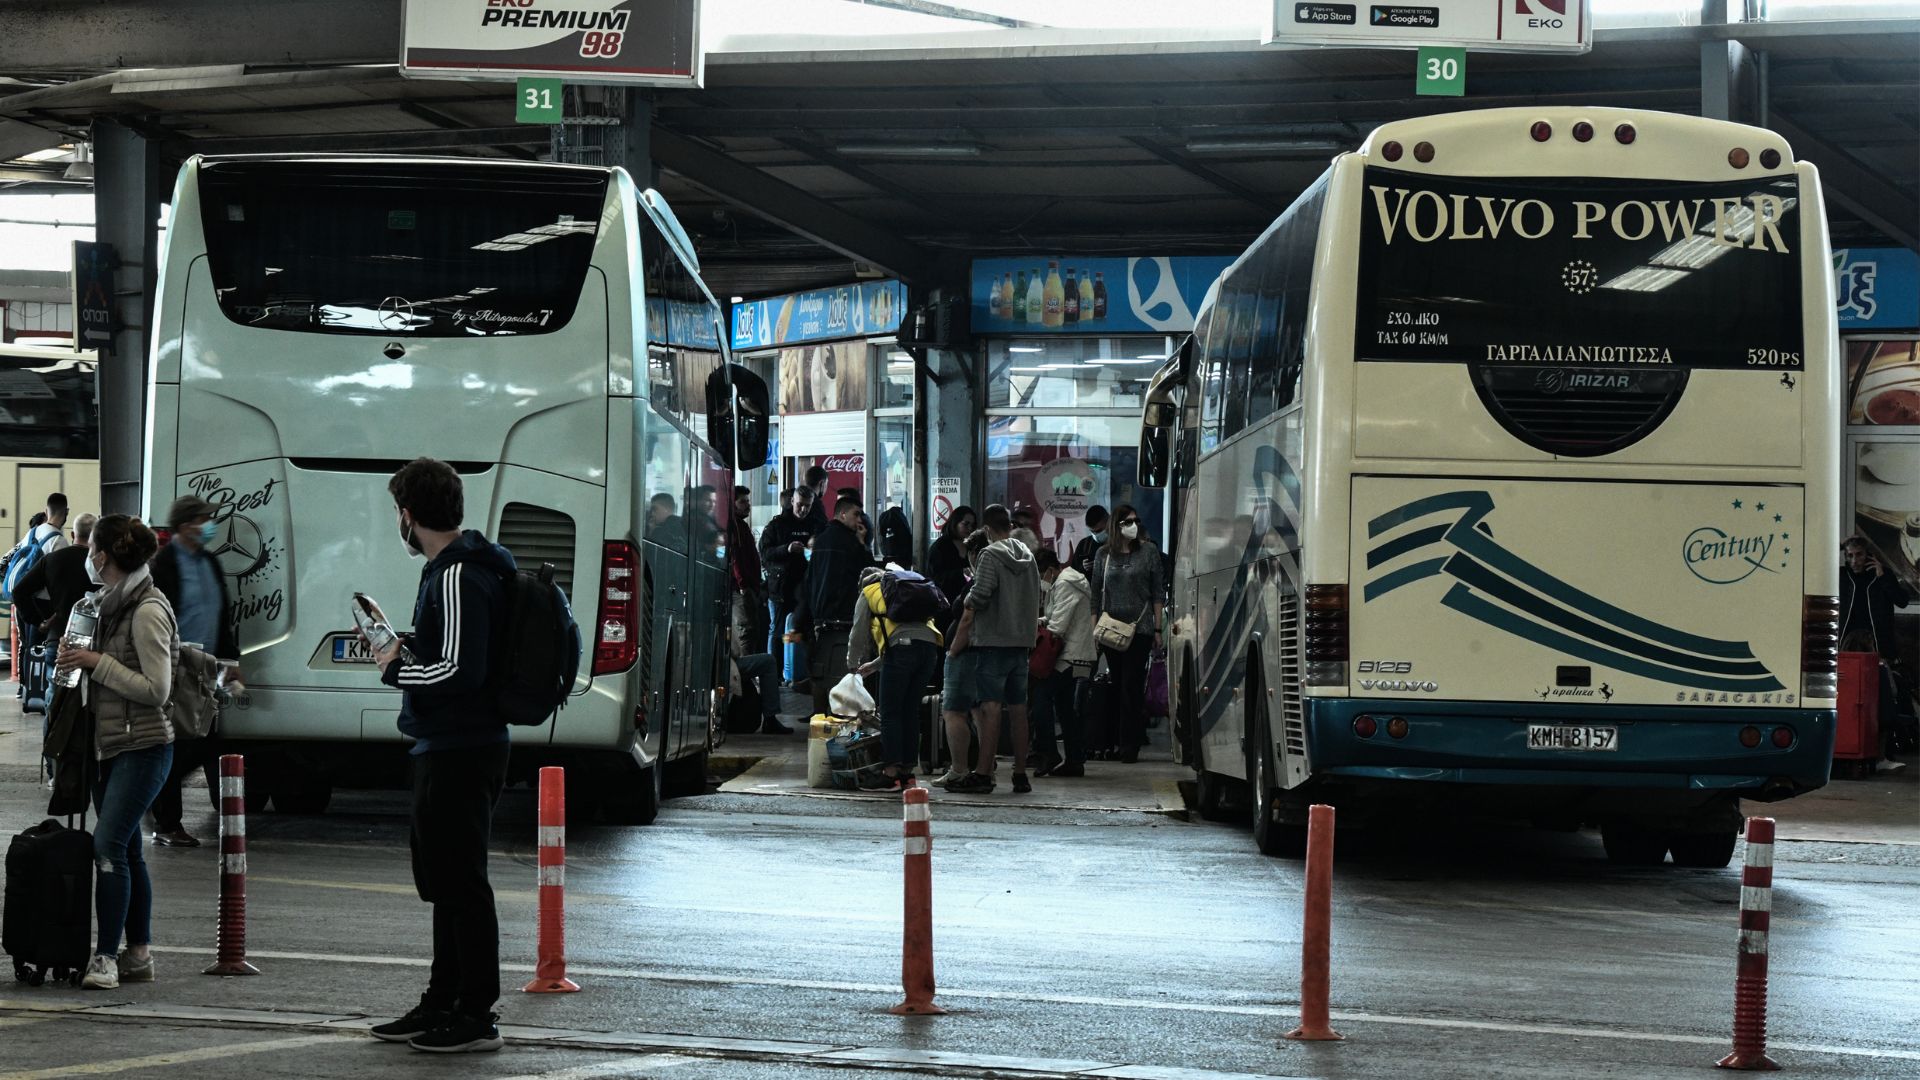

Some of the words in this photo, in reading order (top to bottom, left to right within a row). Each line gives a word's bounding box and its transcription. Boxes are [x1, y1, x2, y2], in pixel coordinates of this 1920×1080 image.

[481, 8, 628, 30] PREMIUM
[1312, 11, 1328, 21] App
[1330, 12, 1351, 21] Store
[1391, 14, 1418, 24] Google
[1419, 15, 1434, 25] Play
[1528, 18, 1563, 29] EKO
[581, 31, 621, 56] 98
[1426, 58, 1458, 81] 30
[524, 88, 553, 109] 31
[1370, 185, 1554, 245] VOLVO
[1572, 192, 1790, 254] POWER
[1570, 269, 1590, 286] 57
[451, 309, 466, 326] by
[469, 309, 539, 327] Mitropoulos
[1401, 331, 1416, 344] 60
[1486, 344, 1674, 365] ΓΑΡΓΑΛΙΑΝΙΩΤΙΣΣΑ
[1569, 374, 1630, 388] IRIZAR
[188, 472, 222, 497] The
[206, 477, 284, 524] Best
[1684, 530, 1778, 574] Century
[1357, 679, 1438, 692] VOLVO
[1676, 692, 1796, 704] SARACAKIS
[1531, 727, 1563, 747] KMH
[1571, 728, 1615, 748] 8157
